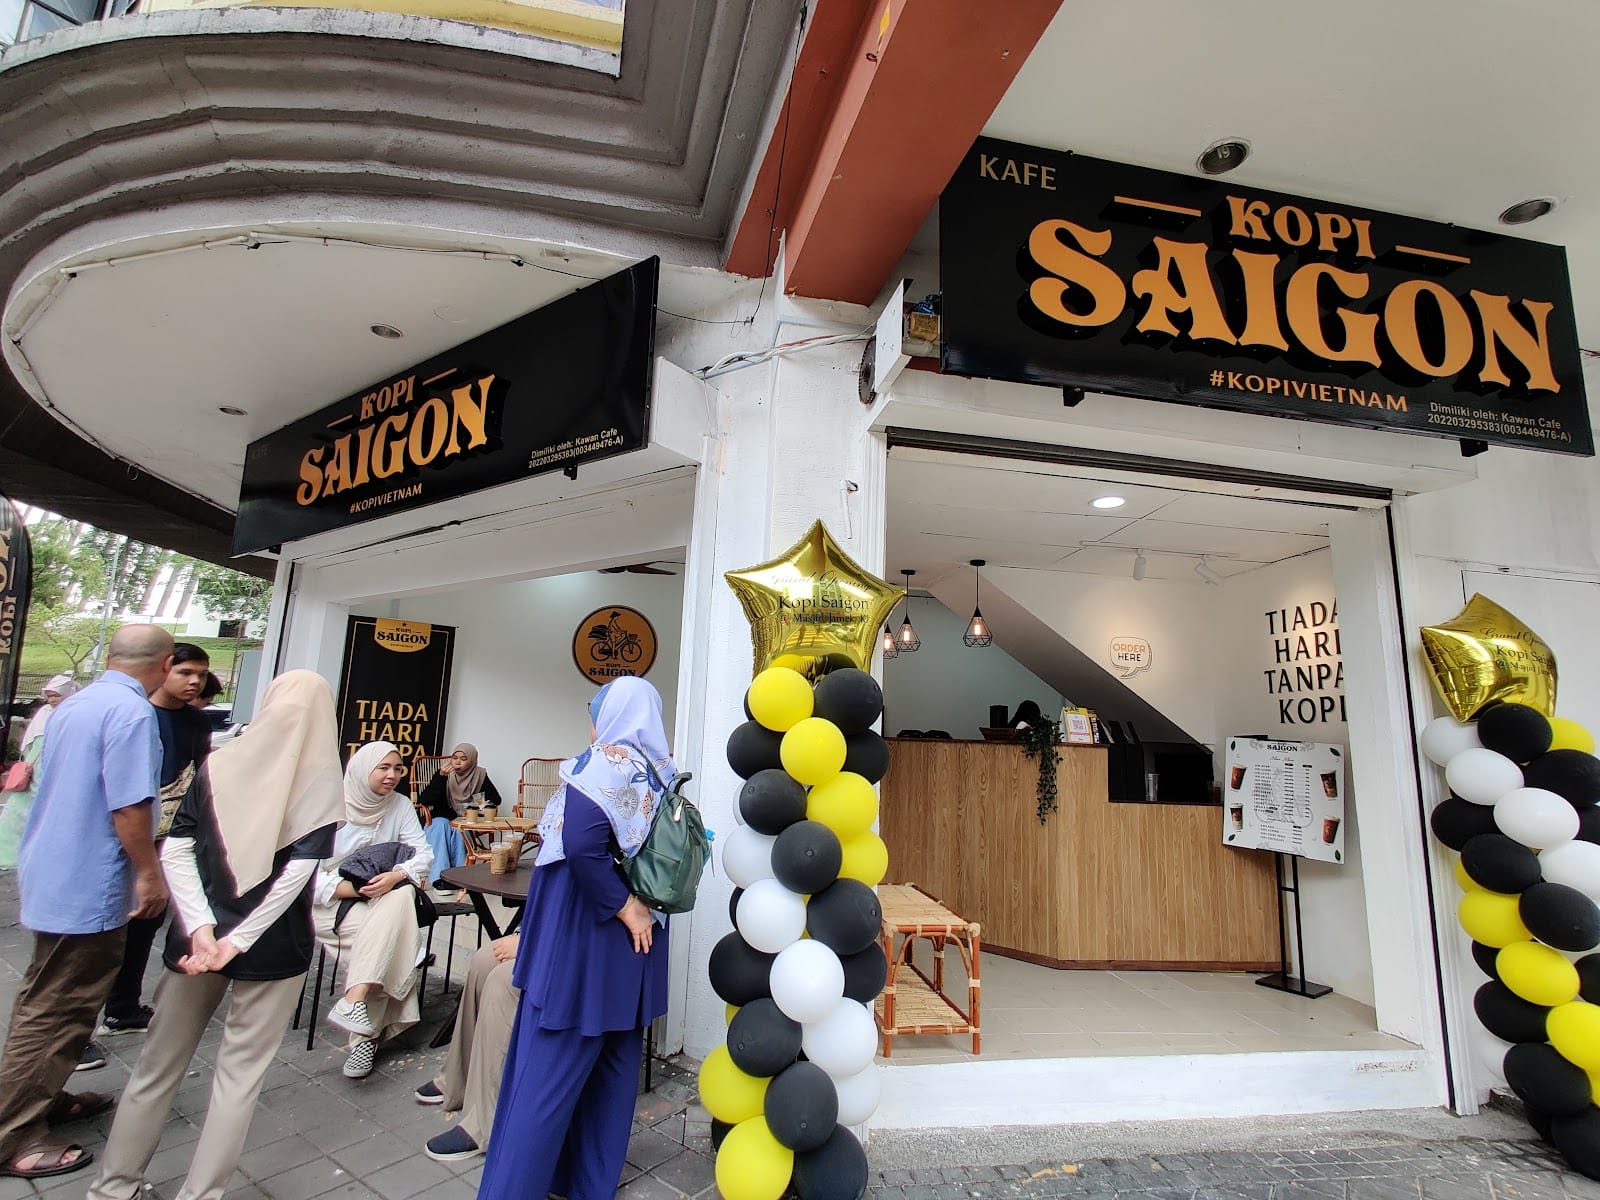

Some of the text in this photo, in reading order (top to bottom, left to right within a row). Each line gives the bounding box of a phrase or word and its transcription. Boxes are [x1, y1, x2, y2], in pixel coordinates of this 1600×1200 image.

[979, 154, 1057, 191] KAFE
[1226, 195, 1377, 260] KOPI
[1027, 219, 1561, 395] SAIGON
[360, 375, 416, 422] KOPI
[1209, 370, 1408, 413] #KOPIVIETNAM
[1427, 413, 1572, 443] 202203295383(003449476-A)
[1430, 402, 1561, 430] Dimiliki oleh: Kawan Cafe
[296, 374, 496, 506] SAIGON
[531, 427, 618, 459] Dimiliki oleh: Kawan Cafe
[350, 483, 422, 514] #KOPIVIETNAM
[779, 594, 869, 613] Kopi Saigon
[377, 631, 428, 645] SAIGON
[1113, 643, 1146, 653] ORDER
[1275, 629, 1341, 664] HARI
[1118, 653, 1141, 661] HERE
[1496, 645, 1529, 662] Kopi
[589, 667, 636, 677] SAIGON
[1264, 662, 1344, 694] TANPA
[356, 700, 429, 722] TIADA
[1279, 695, 1348, 724] KOPI
[360, 722, 422, 743] HARI
[346, 742, 426, 761] TPA
[1266, 744, 1298, 752] SAIGON
